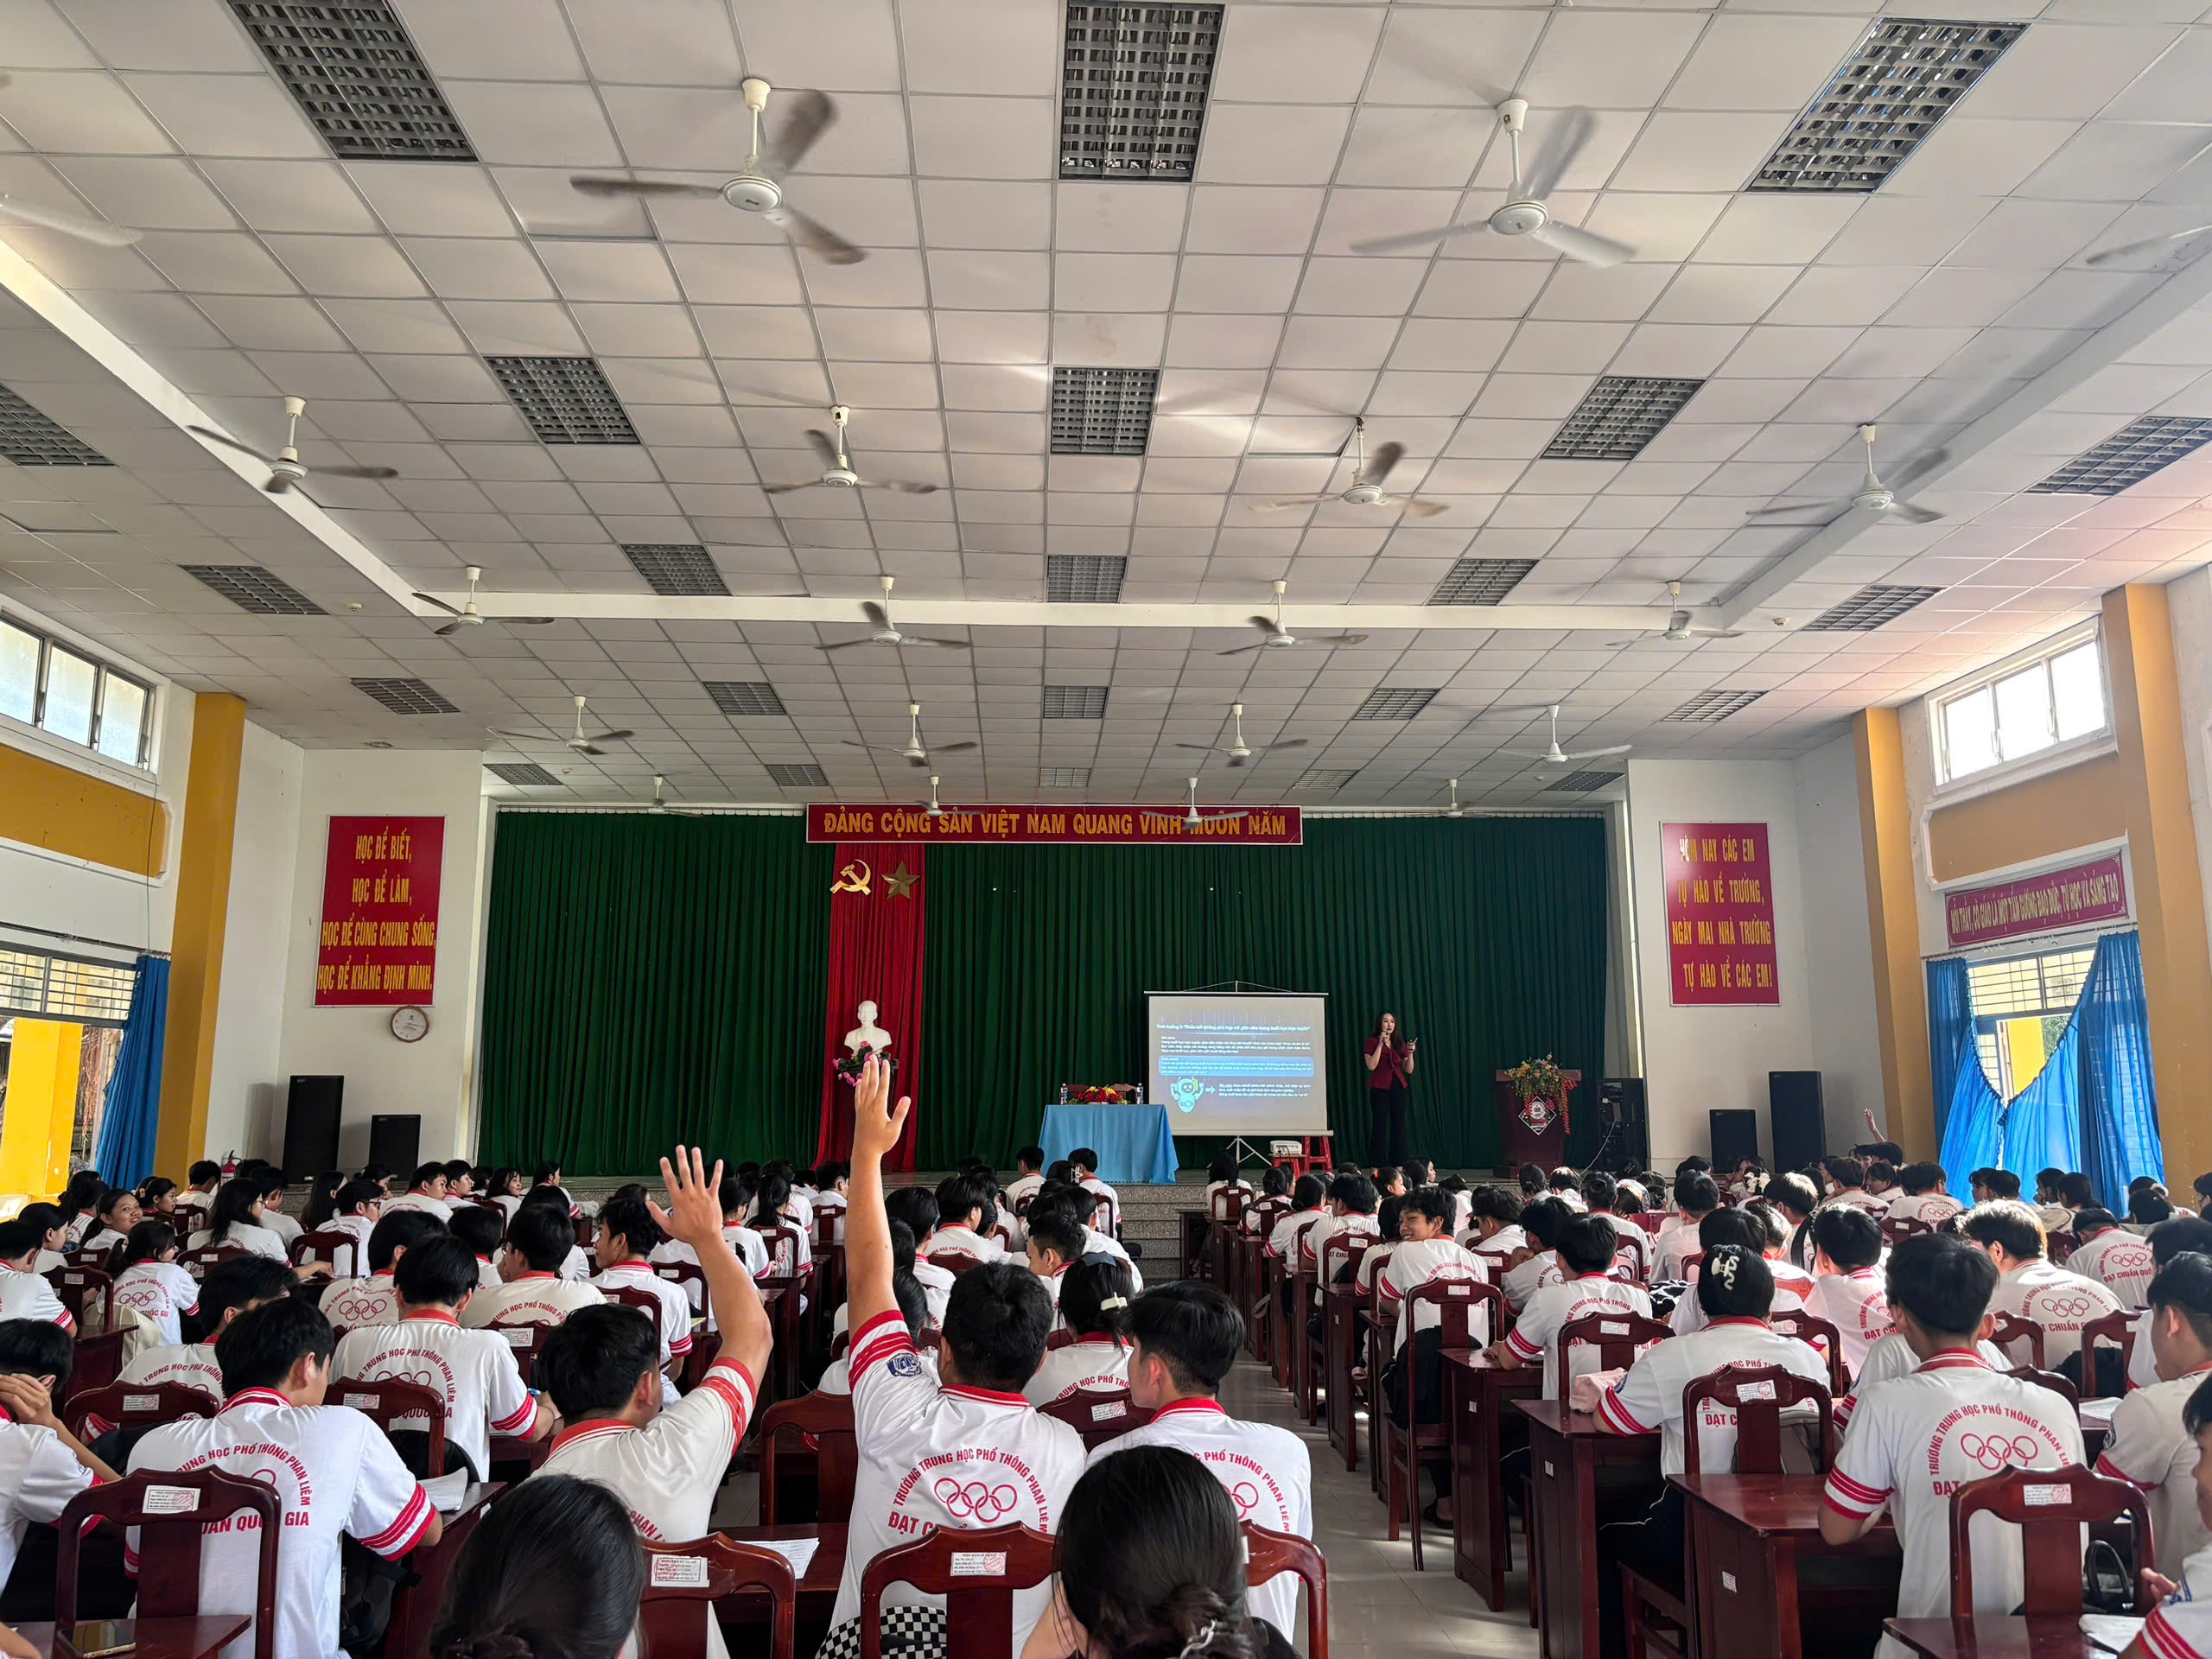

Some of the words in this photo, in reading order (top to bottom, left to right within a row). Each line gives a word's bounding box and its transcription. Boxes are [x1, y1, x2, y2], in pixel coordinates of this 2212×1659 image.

[824, 806, 874, 833] ĐẢNG
[880, 809, 931, 837] CỘNG
[938, 807, 972, 833] SẢN
[981, 810, 1020, 837] VIỆT
[1027, 814, 1065, 834] NAM
[1073, 814, 1133, 836] QUANG
[1249, 811, 1286, 835] NĂM
[356, 836, 372, 864] HỌC
[375, 826, 389, 860] ĐỂ
[390, 828, 411, 863] BIẾT,
[1702, 838, 1717, 861] NAY
[1722, 835, 1738, 861] CÁC
[1743, 839, 1754, 861] EM
[353, 879, 369, 906] HỌC
[374, 868, 387, 902] ĐỂ
[390, 874, 411, 906] LÀM,
[1694, 875, 1709, 903] HÀO
[1713, 872, 1725, 903] VỀ
[1729, 873, 1764, 906] TRƯỜNG,
[321, 922, 339, 950] HỌC
[341, 912, 354, 946] ĐỂ
[354, 918, 378, 946] CÙNG
[379, 922, 409, 946] CHUNG
[1672, 918, 1692, 944] NGÀY
[1697, 921, 1713, 944] MAI
[1718, 916, 1735, 944] NHÀ
[1739, 914, 1771, 944] TRƯỜNG
[317, 965, 334, 994] HỌC
[338, 955, 352, 989] ĐỂ
[383, 965, 405, 994] ĐỊNH
[408, 961, 432, 989] MÌNH.
[1683, 961, 1694, 992] TỰ
[1700, 960, 1716, 988] HÀO
[1721, 955, 1732, 988] VỀ
[1736, 960, 1751, 988] CÁC
[1756, 963, 1772, 988] EM!
[363, 1351, 387, 1372] TRUNG
[389, 1348, 404, 1357] HỌC
[421, 1349, 442, 1364] THÔNG
[439, 1362, 454, 1382] PHAN
[1079, 1376, 1096, 1387] HỌC
[1098, 1373, 1115, 1382] PHỔ
[1706, 1414, 1726, 1427] ĐẠT
[1928, 1434, 1942, 1476] TRƯỜNG
[1936, 1409, 1963, 1435] TRUNG
[1961, 1404, 1980, 1416] HỌC
[1982, 1403, 2002, 1415] PHỔ
[2004, 1408, 2038, 1428] THÔNG
[2039, 1425, 2063, 1452] PHAN
[208, 1447, 230, 1459] HỌC
[233, 1442, 257, 1455] PHỔ
[257, 1443, 289, 1461] THÔNG
[286, 1456, 308, 1480] PHAN
[299, 1481, 313, 1506] LIÊM
[893, 1466, 921, 1507] TRƯỜNG
[918, 1452, 955, 1472] TRUNG
[957, 1449, 975, 1462] HỌC
[976, 1446, 998, 1462] PHỔ
[999, 1452, 1031, 1478] THÔNG
[1027, 1474, 1046, 1505] PHAN
[1039, 1506, 1050, 1534] LIÊM
[1204, 1448, 1226, 1461] PHỔ
[1229, 1452, 1262, 1475] THÔNG
[1262, 1472, 1284, 1503] PHAN
[1279, 1505, 1290, 1532] LIÊM
[285, 1512, 309, 1526] GIA
[888, 1511, 919, 1535] ĐẠT
